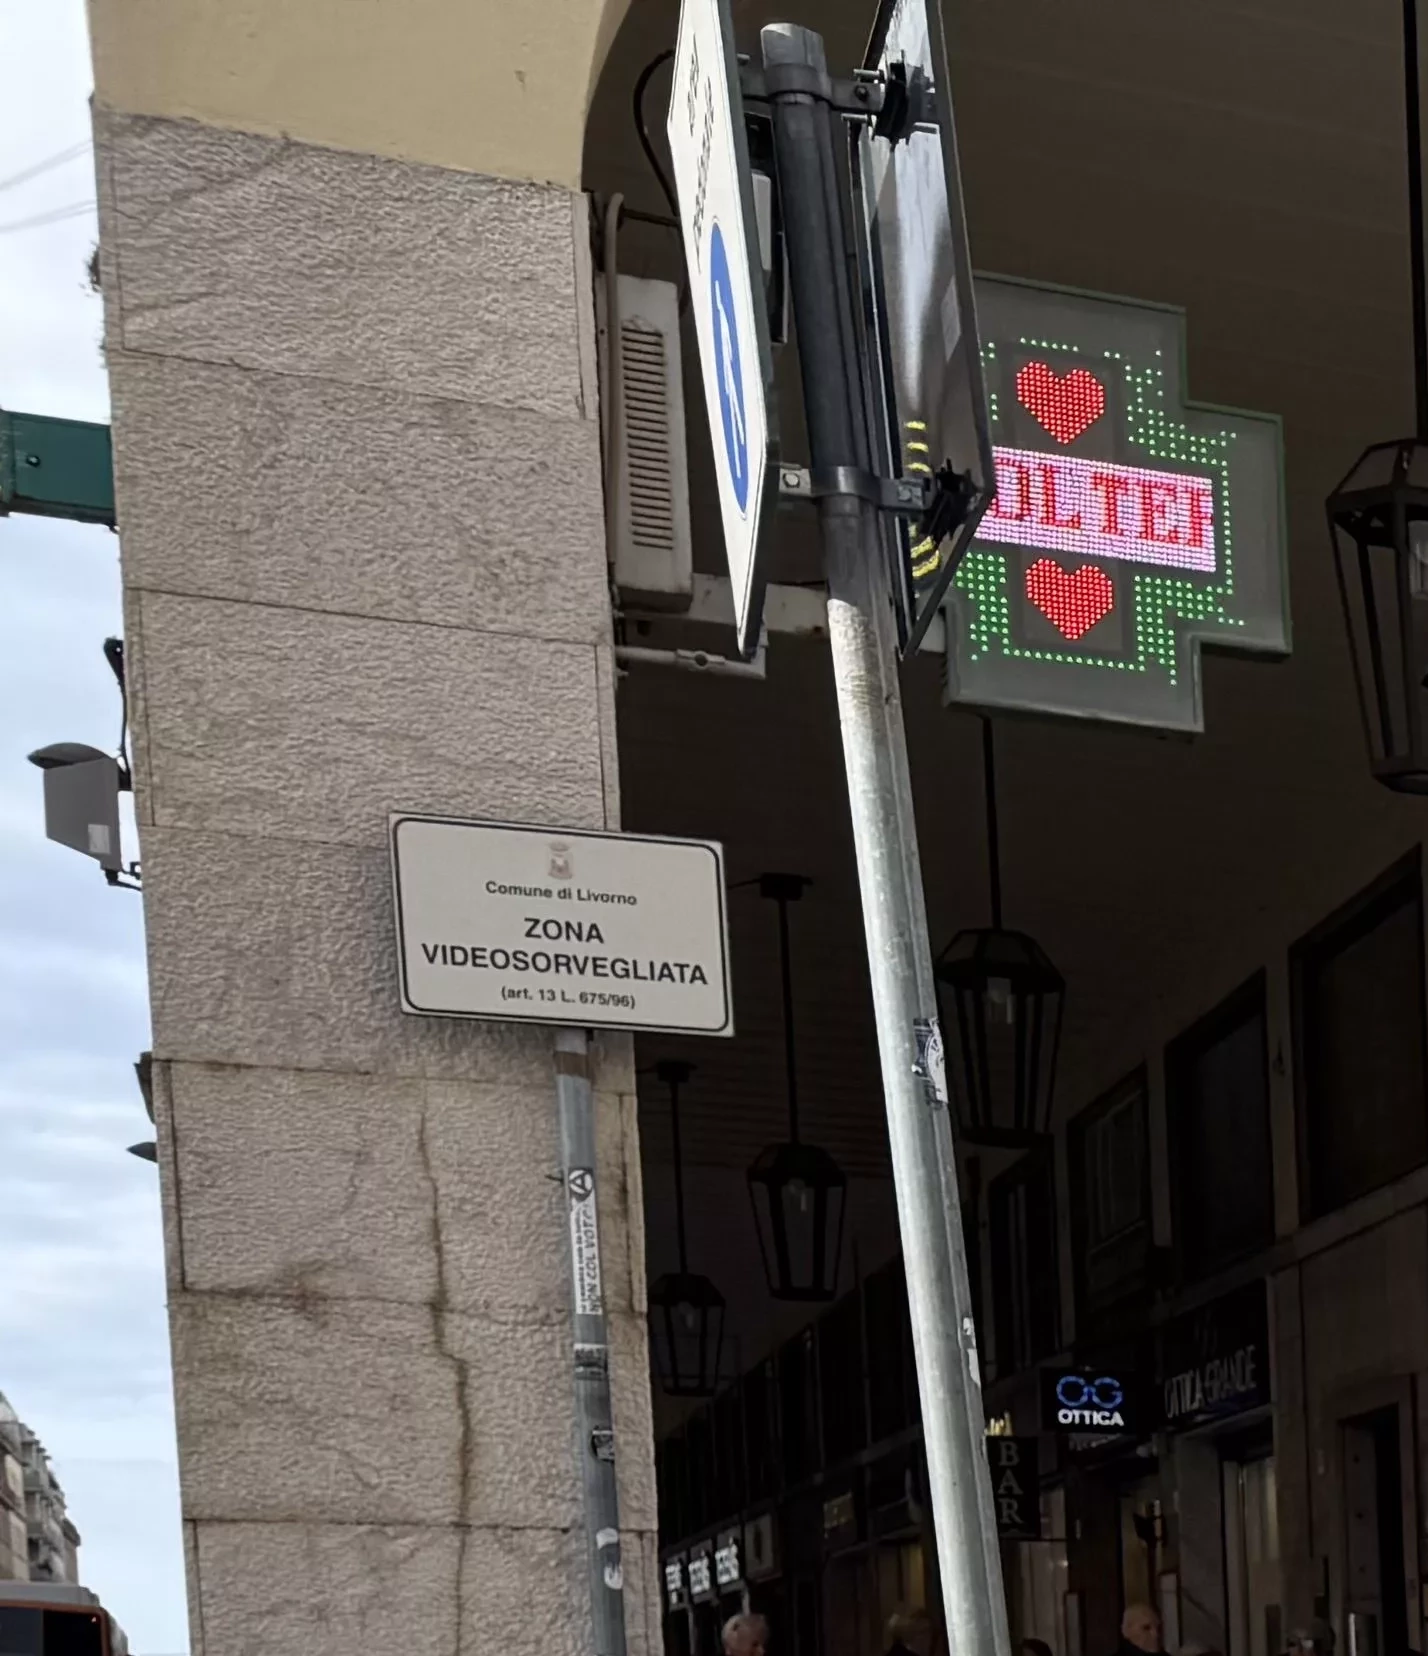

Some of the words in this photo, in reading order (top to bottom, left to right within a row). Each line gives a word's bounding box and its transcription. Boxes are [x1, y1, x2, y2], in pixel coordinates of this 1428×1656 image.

[485, 879, 553, 899] Comune
[557, 886, 572, 900] di
[576, 888, 637, 906] Livorno
[523, 917, 605, 945] ZONA
[421, 942, 709, 986] VIDEOSORVEGLIATA
[501, 986, 533, 1001] (art.
[539, 988, 556, 1002] 13
[560, 989, 576, 1004] L.
[579, 990, 636, 1010] 675/96)
[1056, 1407, 1126, 1428] OTTICA
[996, 1440, 1026, 1525] BAR
